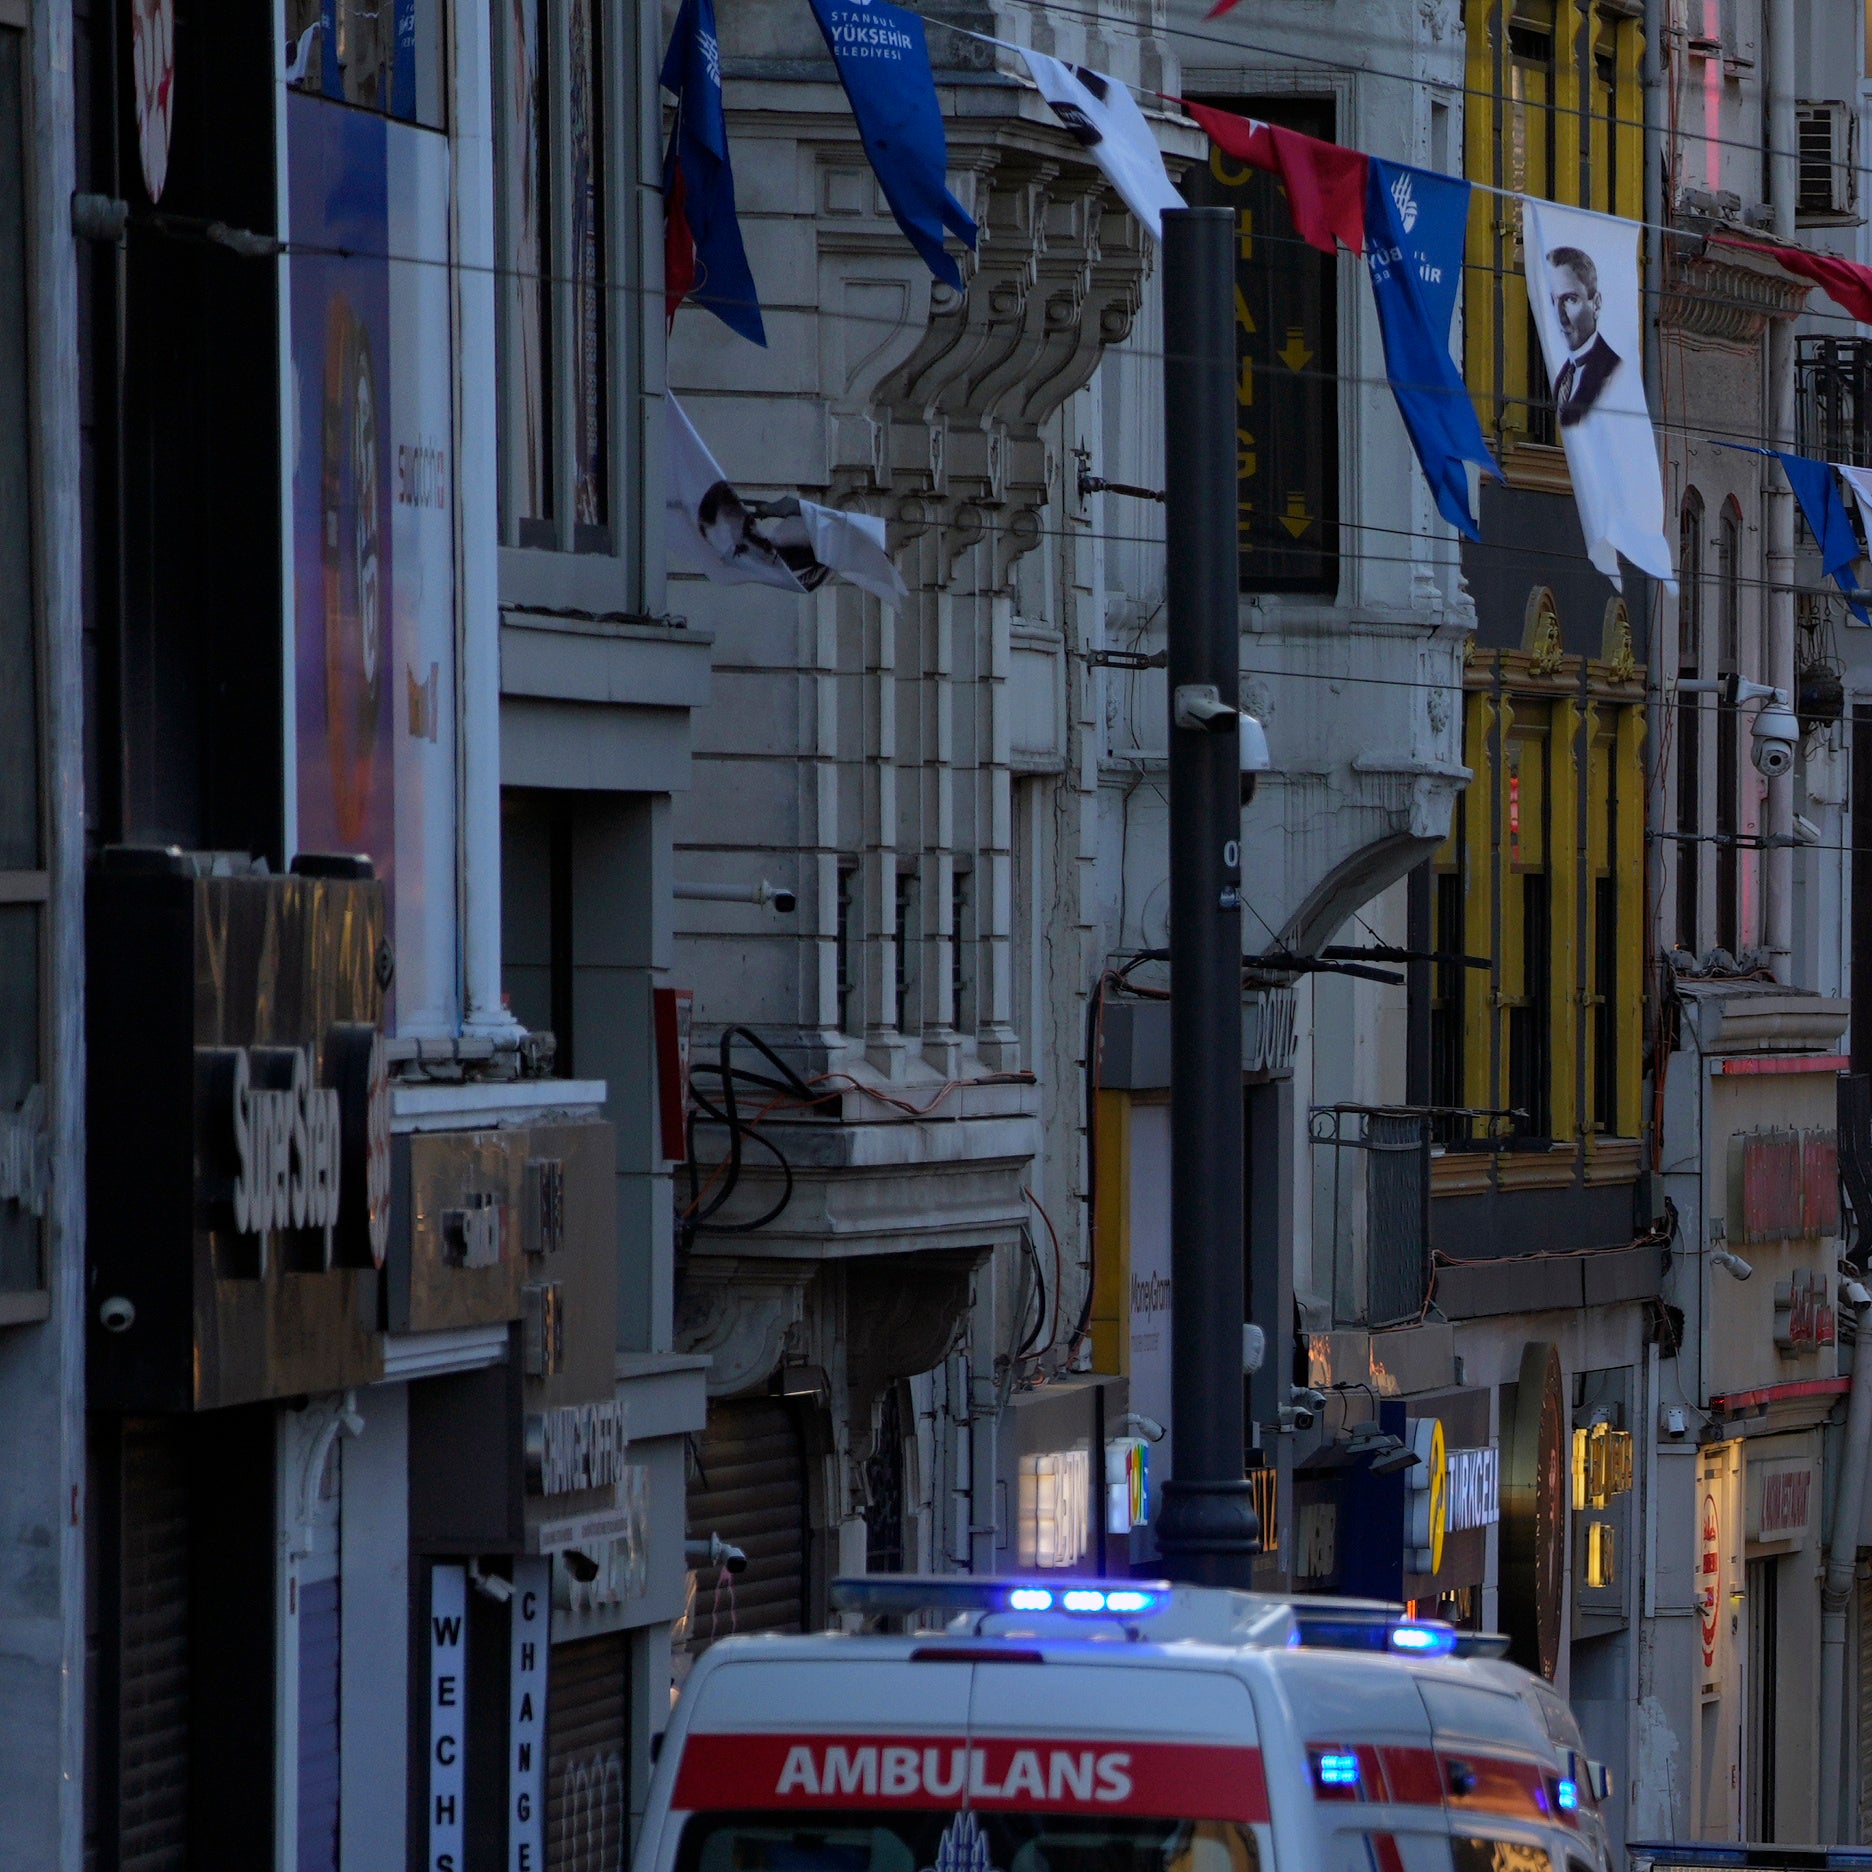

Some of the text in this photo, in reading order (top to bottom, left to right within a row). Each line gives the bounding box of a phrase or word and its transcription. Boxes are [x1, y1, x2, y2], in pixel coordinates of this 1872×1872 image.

[831, 26, 912, 53] YÜKŞEHİR
[834, 46, 902, 61] ELEDİYESİ
[1448, 1448, 1500, 1532] TURKCELL
[775, 1744, 1132, 1804] AMBULANS
